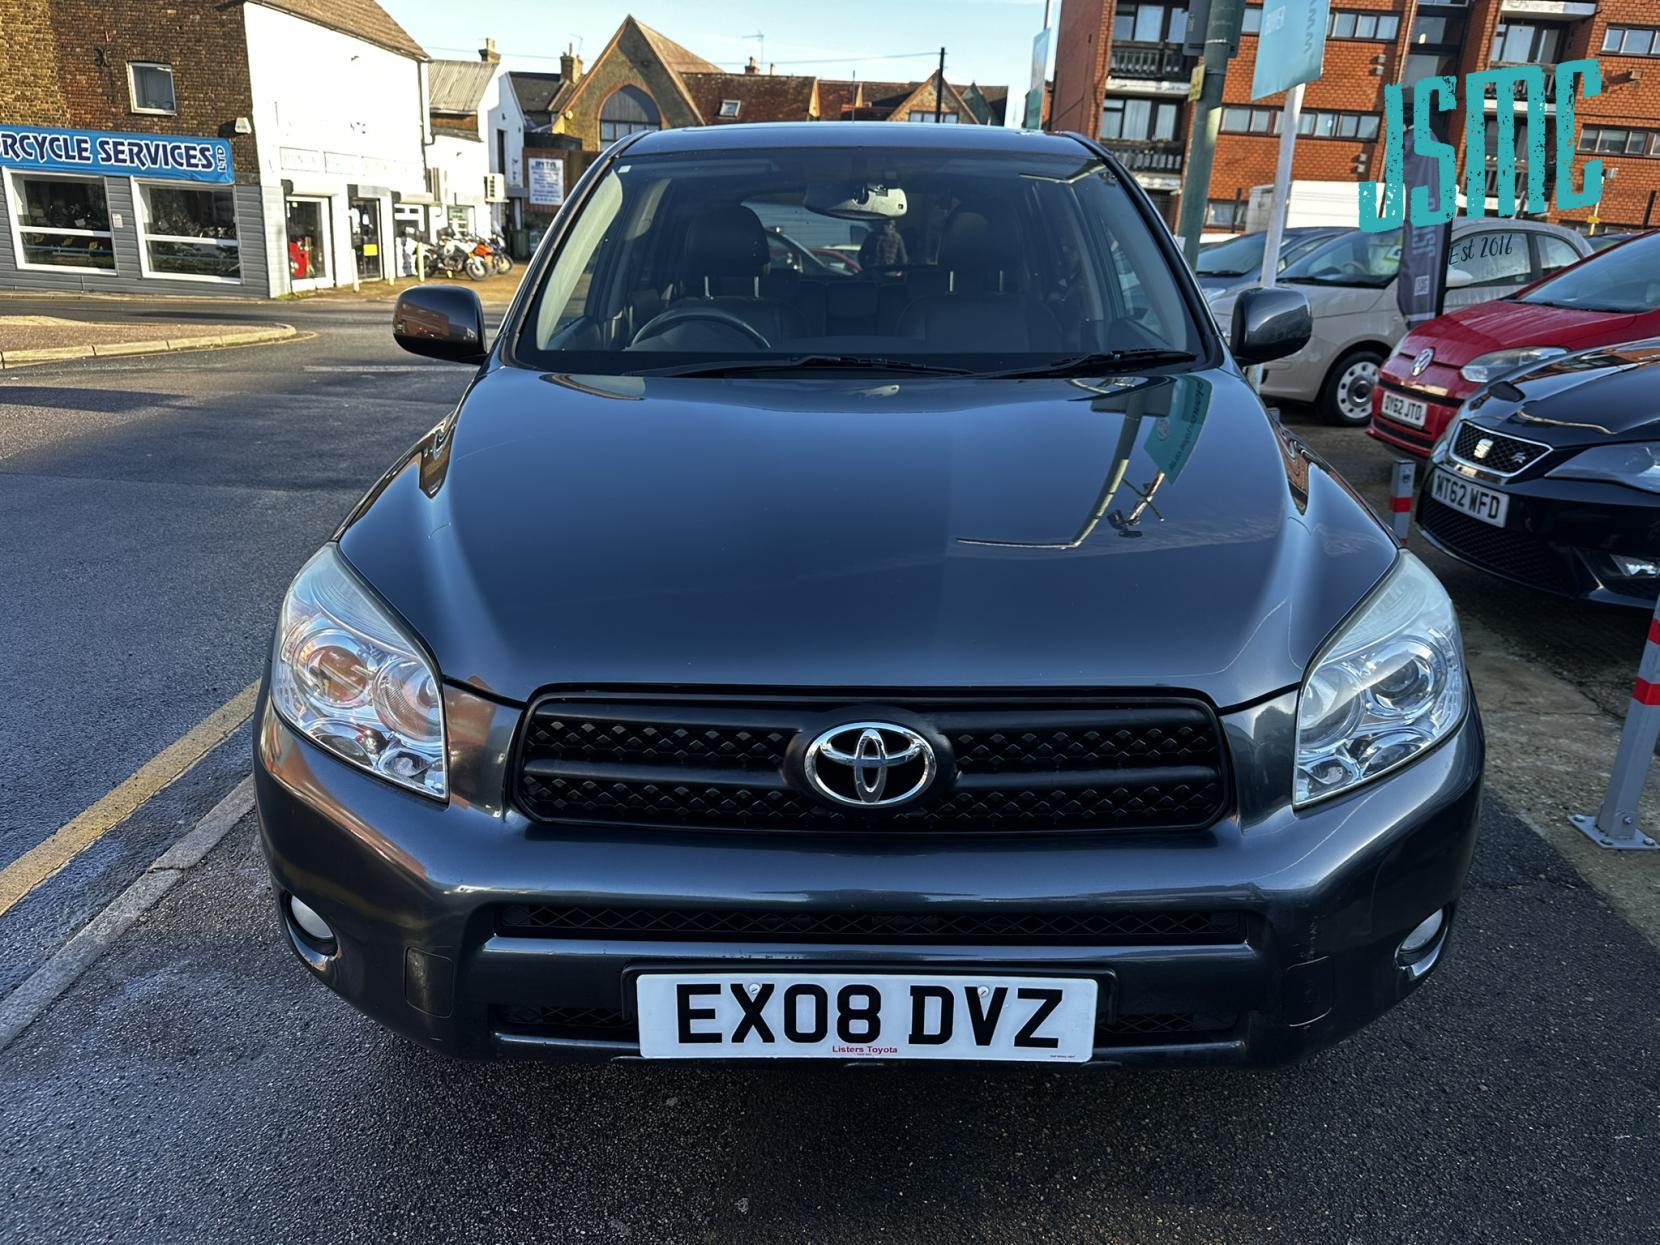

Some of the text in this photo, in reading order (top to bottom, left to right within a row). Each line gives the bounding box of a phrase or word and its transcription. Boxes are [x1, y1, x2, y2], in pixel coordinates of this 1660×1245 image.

[97, 137, 213, 172] SERVICES
[216, 146, 227, 172] LTD
[676, 983, 1064, 1049] EX08 DVZ
[832, 1045, 898, 1055] Listers Toyota
